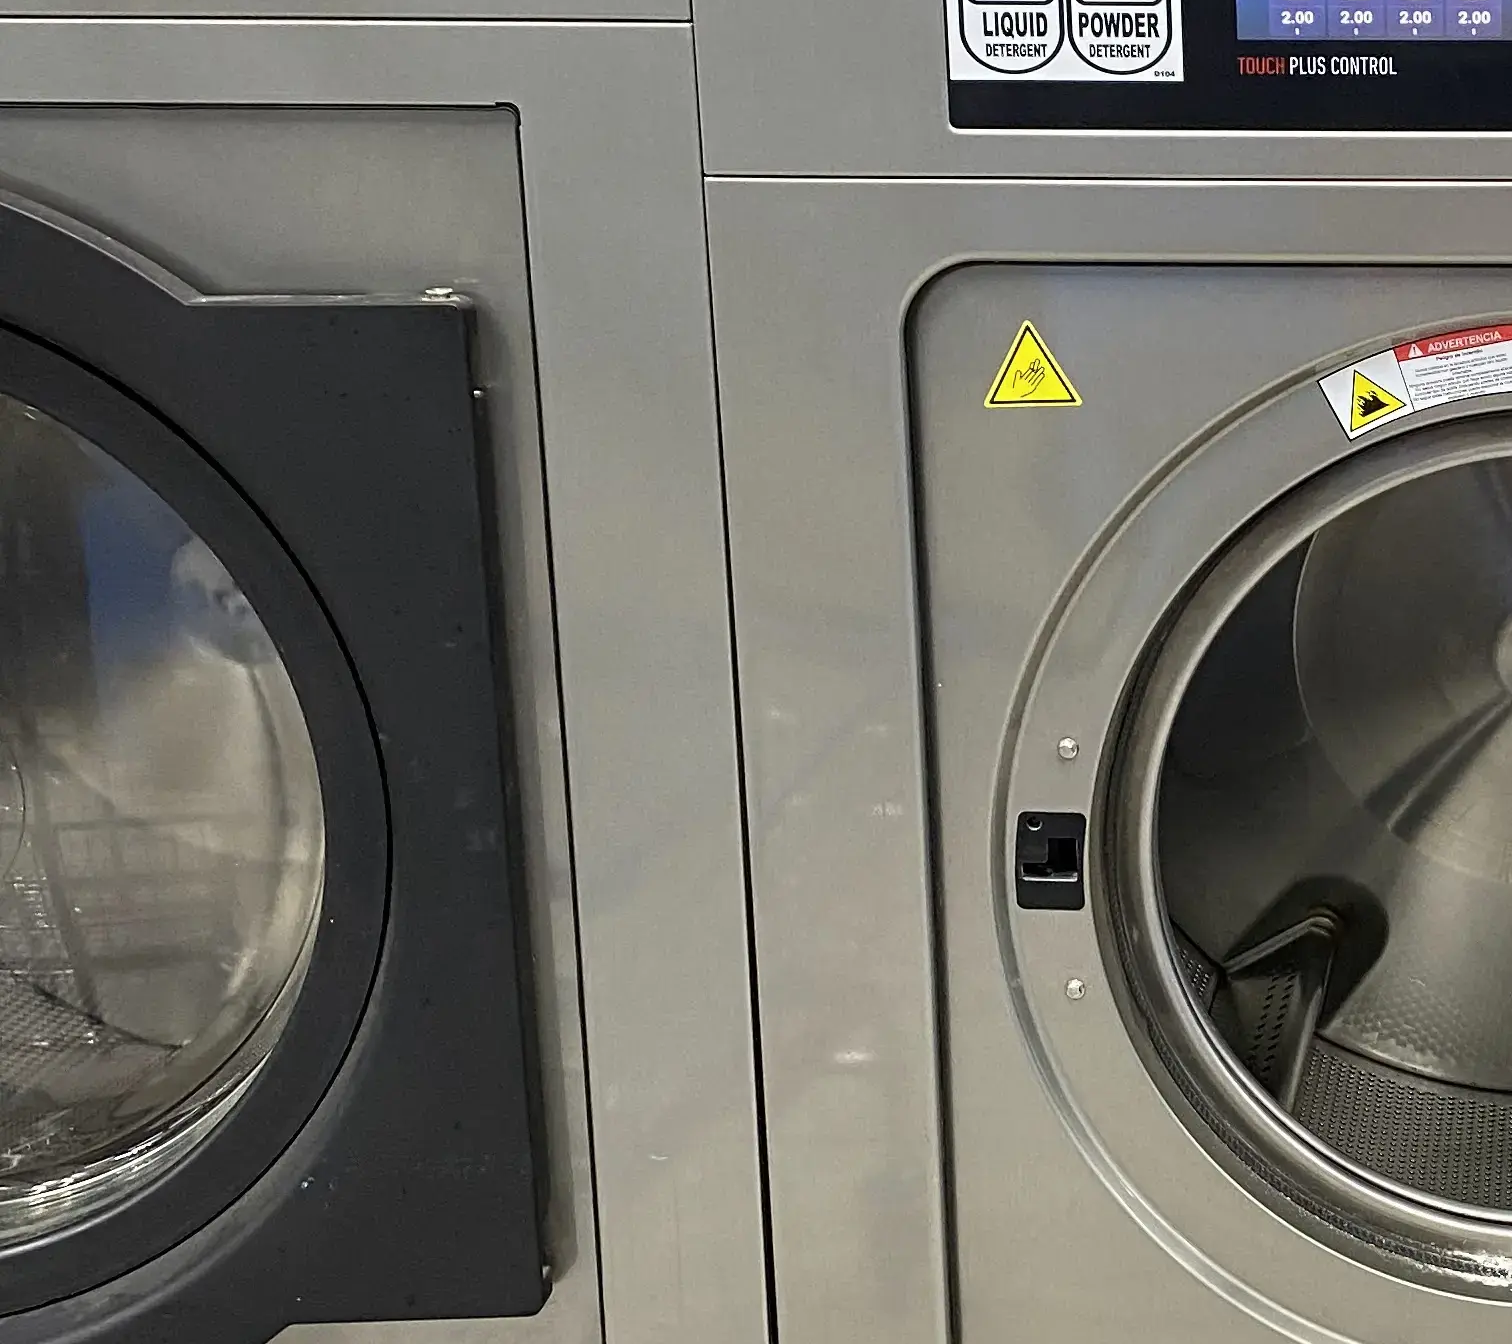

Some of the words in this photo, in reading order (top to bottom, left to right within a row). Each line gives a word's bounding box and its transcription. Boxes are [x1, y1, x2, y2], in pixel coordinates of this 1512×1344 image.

[983, 11, 1048, 39] LIQUID
[1078, 12, 1160, 38] POWDER
[1281, 10, 1314, 25] 2.00
[1340, 10, 1373, 25] 2.00
[1399, 10, 1432, 25] 2.00
[1458, 10, 1491, 25] 2.00
[985, 44, 1048, 58] DETERGENT
[1089, 44, 1150, 58] DETERGENT
[1237, 57, 1285, 75] TOUCH
[1290, 56, 1326, 75] PLUS
[1331, 56, 1398, 75] CONTROL
[1427, 330, 1502, 353] ADVERTENCIA
